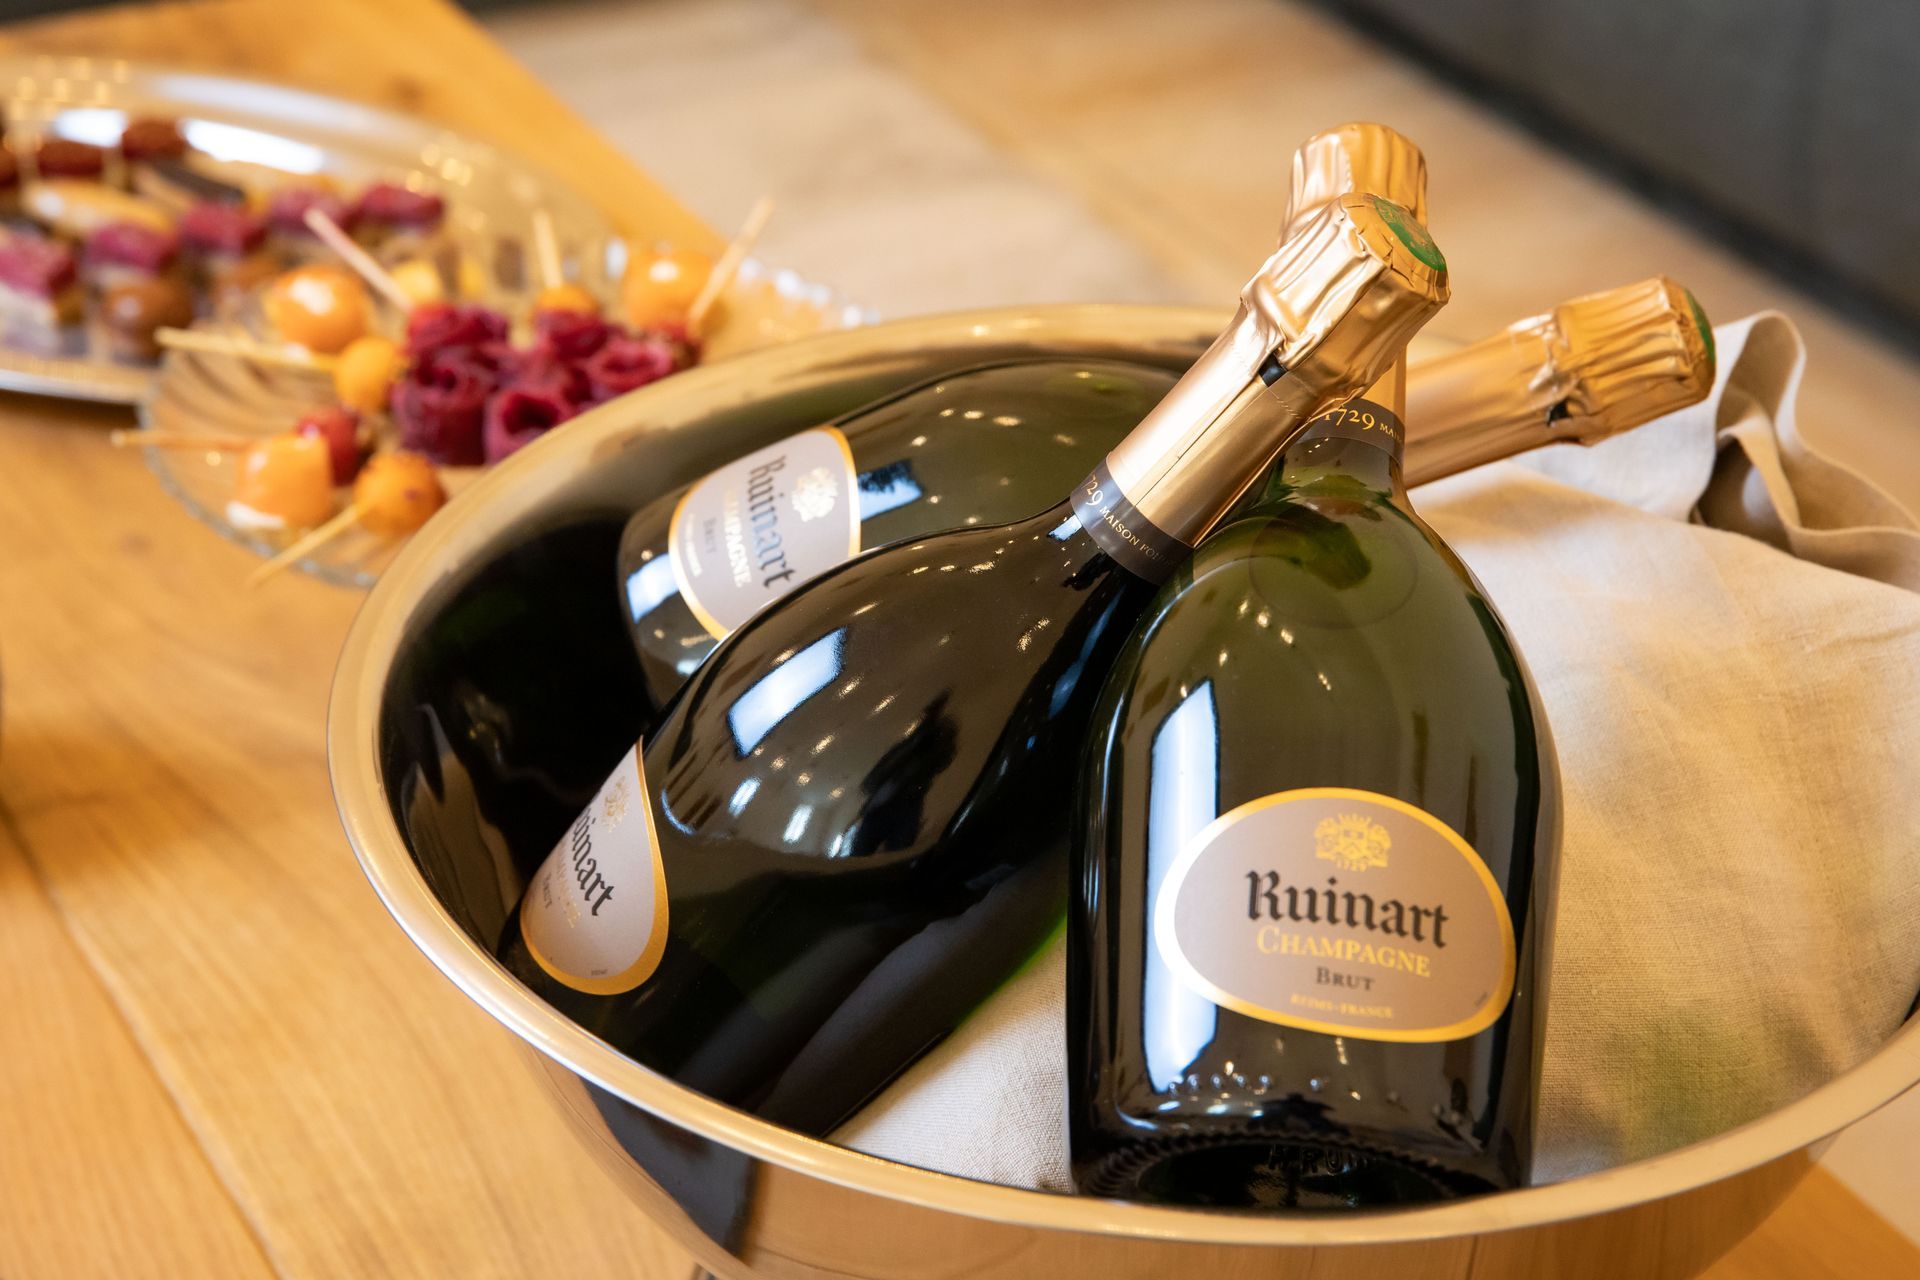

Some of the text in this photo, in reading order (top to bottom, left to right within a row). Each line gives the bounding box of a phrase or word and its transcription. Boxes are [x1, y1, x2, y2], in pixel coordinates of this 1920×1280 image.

[748, 455, 796, 589] Ruinart
[1099, 505, 1141, 546] MAISON
[1245, 869, 1449, 949] Ruinart
[1255, 924, 1432, 978] CHAMPAGNE
[1315, 966, 1375, 991] BRUT
